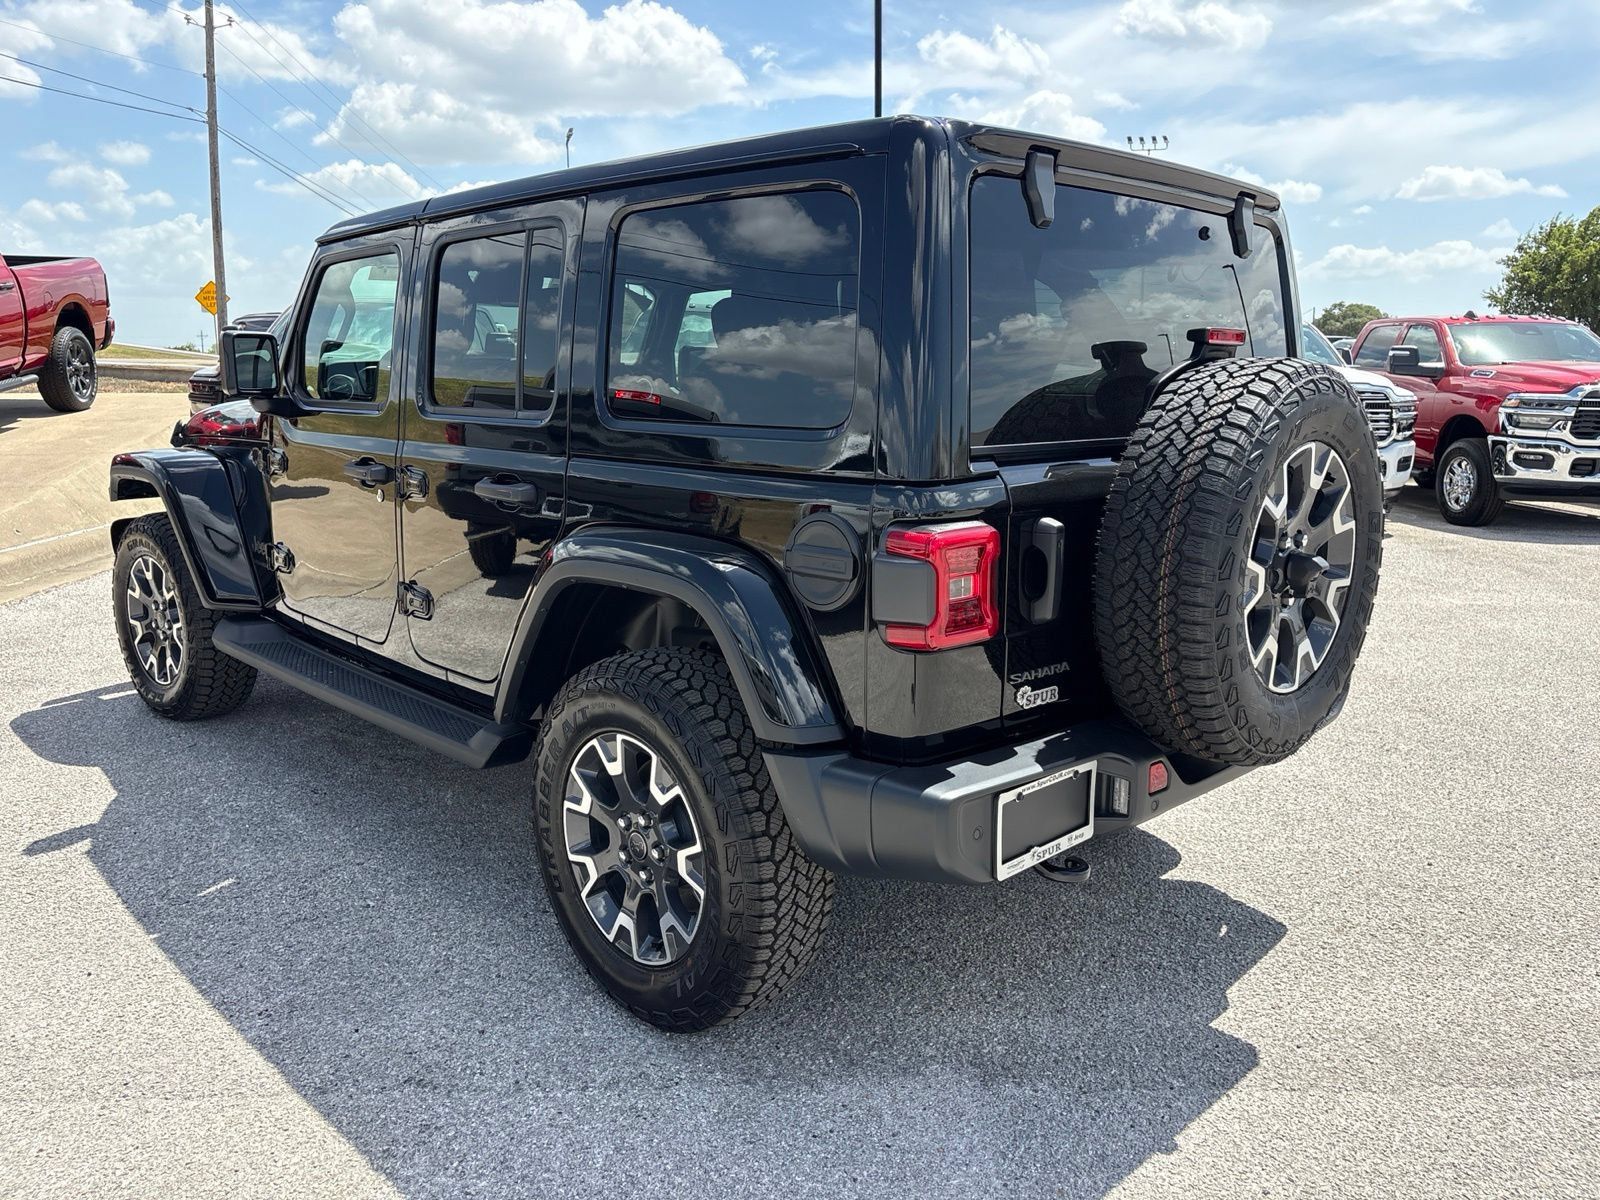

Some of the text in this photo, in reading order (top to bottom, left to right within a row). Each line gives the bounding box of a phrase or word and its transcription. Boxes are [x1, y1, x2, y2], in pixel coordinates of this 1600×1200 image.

[1326, 511, 1381, 691] GENERAL
[1009, 661, 1071, 685] SAHARA
[1025, 688, 1057, 707] SPUR
[562, 705, 590, 742] A/T
[1036, 843, 1062, 861] SPUR
